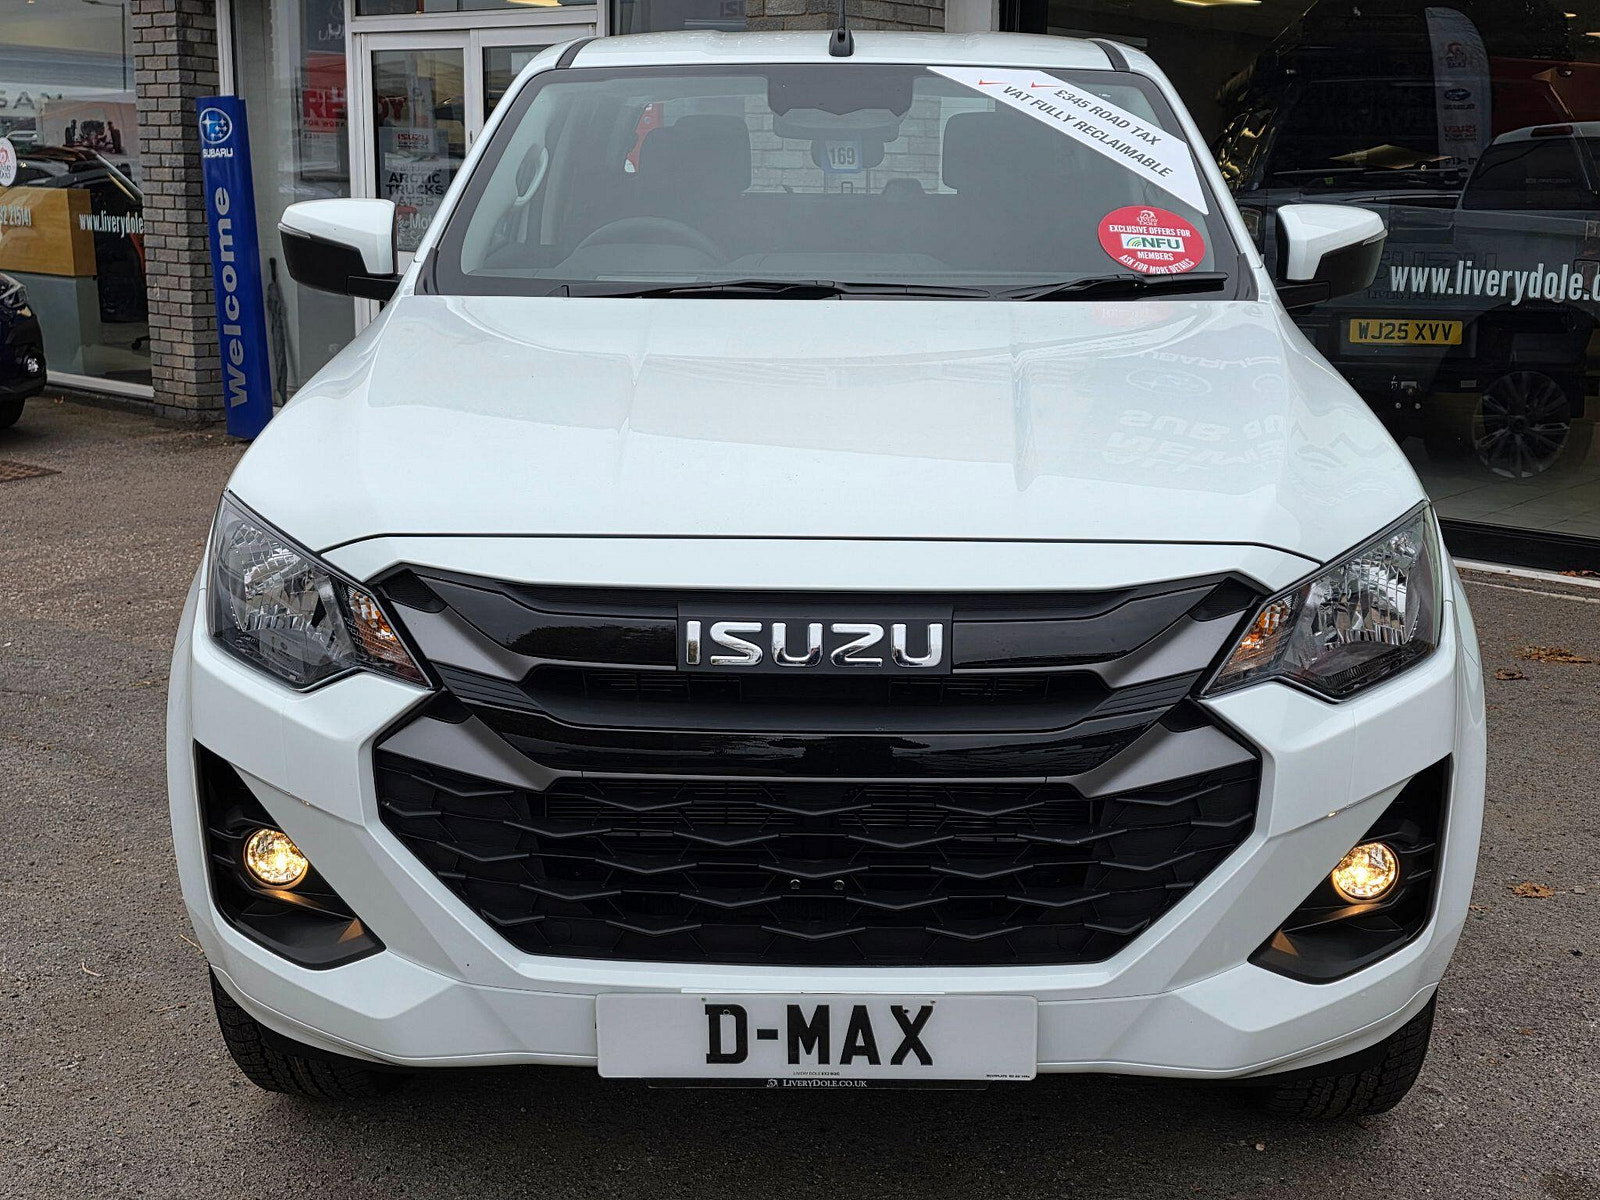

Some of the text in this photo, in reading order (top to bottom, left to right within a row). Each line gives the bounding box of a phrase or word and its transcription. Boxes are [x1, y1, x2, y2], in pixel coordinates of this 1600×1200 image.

[1054, 89, 1162, 146] £345 ROAD TAX
[1003, 86, 1173, 177] VAT FULLY RECLAIMABLE
[202, 147, 234, 158] SUBARU
[829, 146, 855, 165] 169
[388, 172, 441, 184] ARCTIC
[386, 184, 445, 195] TRUCKS
[1108, 225, 1192, 237] EXCLUSIVE OFFERS FOR
[1140, 237, 1181, 250] NFU
[1118, 254, 1195, 275] ASK FOR MORE DETAILS
[1137, 251, 1175, 261] MEMBERS
[214, 187, 248, 408] welcome
[1357, 321, 1454, 342] WJ25 XVV
[686, 619, 944, 668] ISUZU
[705, 1003, 934, 1067] D-MAX
